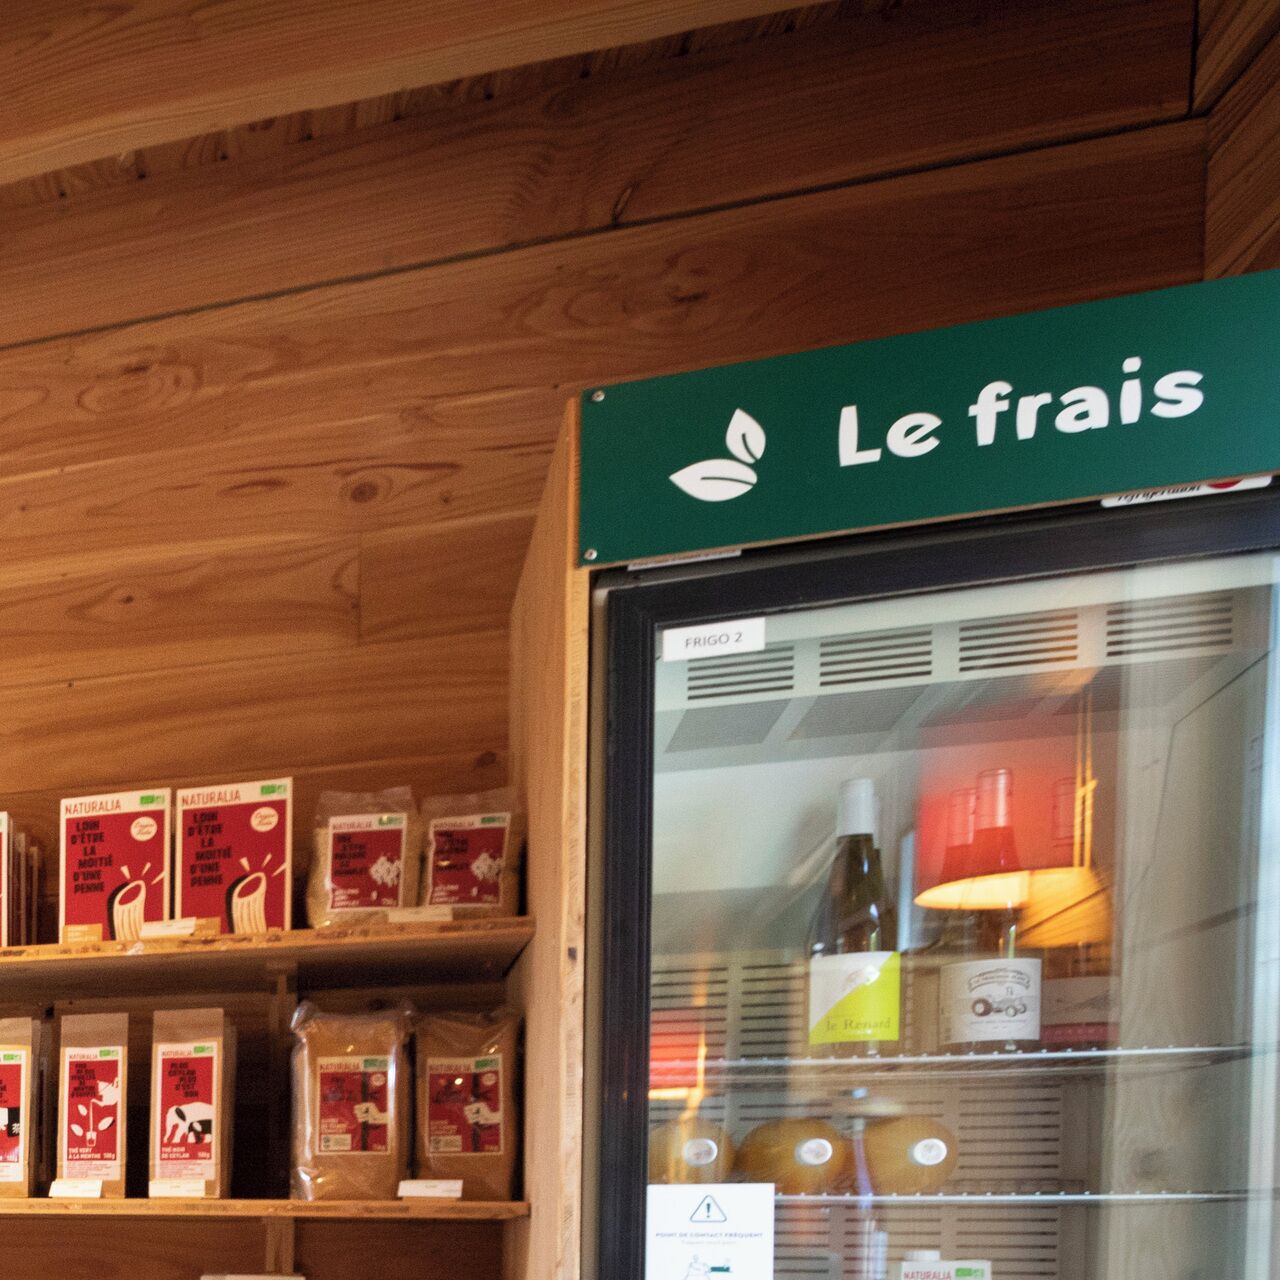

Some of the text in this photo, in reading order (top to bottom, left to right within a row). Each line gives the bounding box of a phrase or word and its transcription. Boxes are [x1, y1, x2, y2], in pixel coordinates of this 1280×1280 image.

[840, 356, 1204, 466] Le frais
[685, 632, 742, 648] FRIGO 2
[182, 790, 240, 806] NATURALIA
[65, 799, 121, 815] NATURALIA
[904, 1271, 951, 1280] NATURALIA
